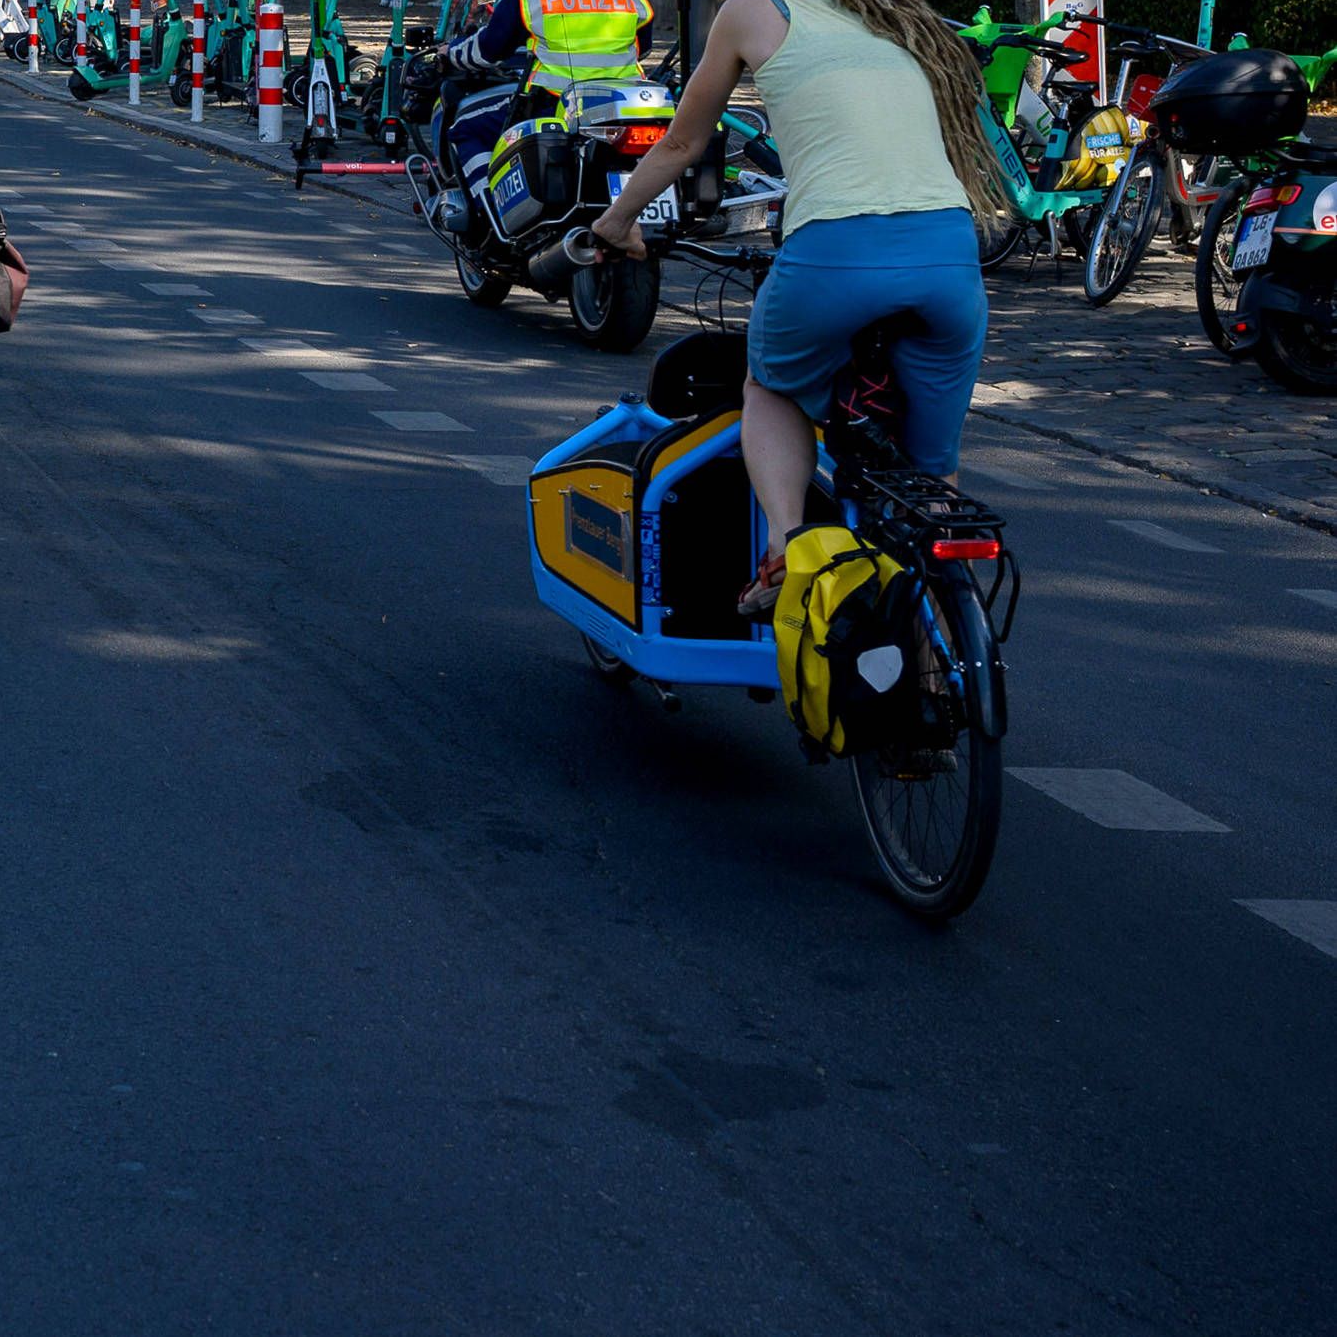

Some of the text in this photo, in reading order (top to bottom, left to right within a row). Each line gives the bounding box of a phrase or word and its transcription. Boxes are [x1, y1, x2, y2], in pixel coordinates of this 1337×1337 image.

[1086, 133, 1122, 148] FRISCHE
[1089, 147, 1105, 159] FÜR
[995, 127, 1027, 193] TIER
[494, 168, 525, 210] POLIZEI
